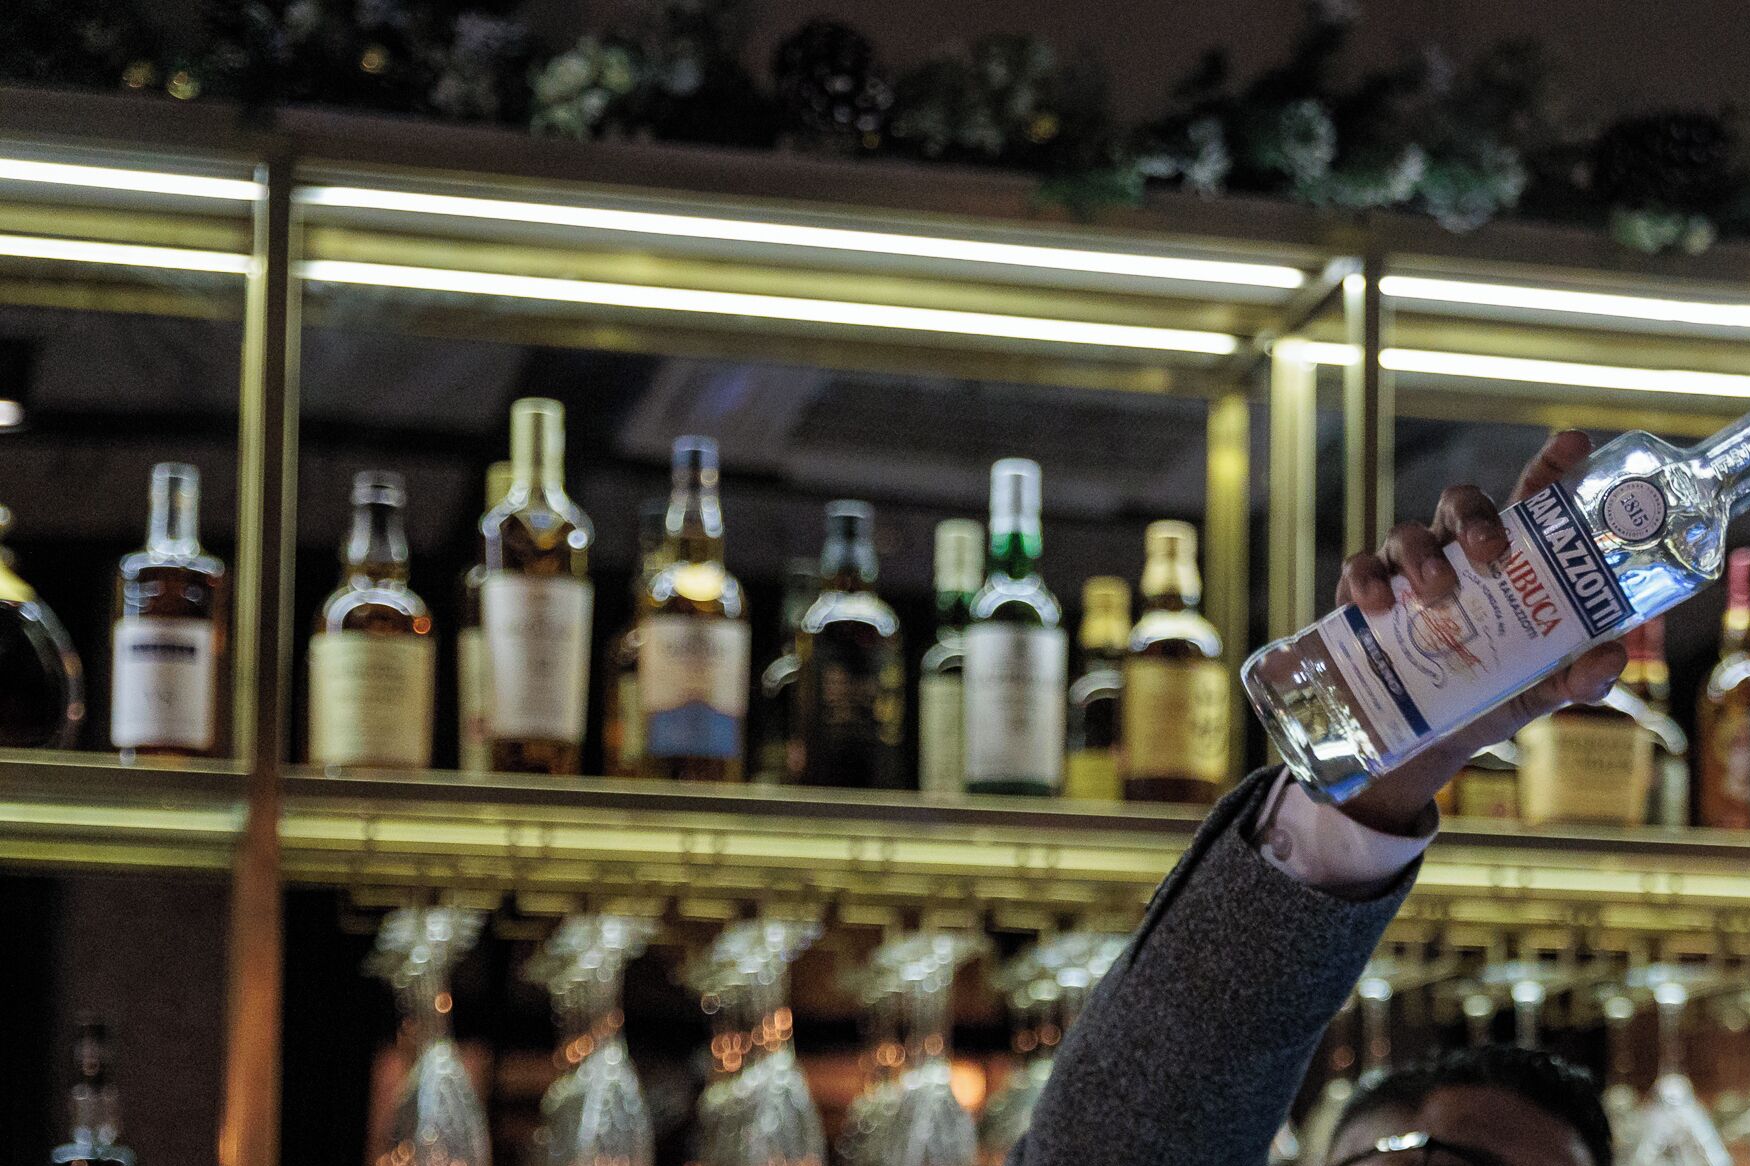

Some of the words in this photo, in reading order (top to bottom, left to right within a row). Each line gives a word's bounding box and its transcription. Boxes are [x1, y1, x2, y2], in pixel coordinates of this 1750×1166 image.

[1525, 488, 1622, 628] RAMAZZOTTI
[1620, 492, 1649, 528] 1815
[1503, 526, 1563, 638] MBUCA
